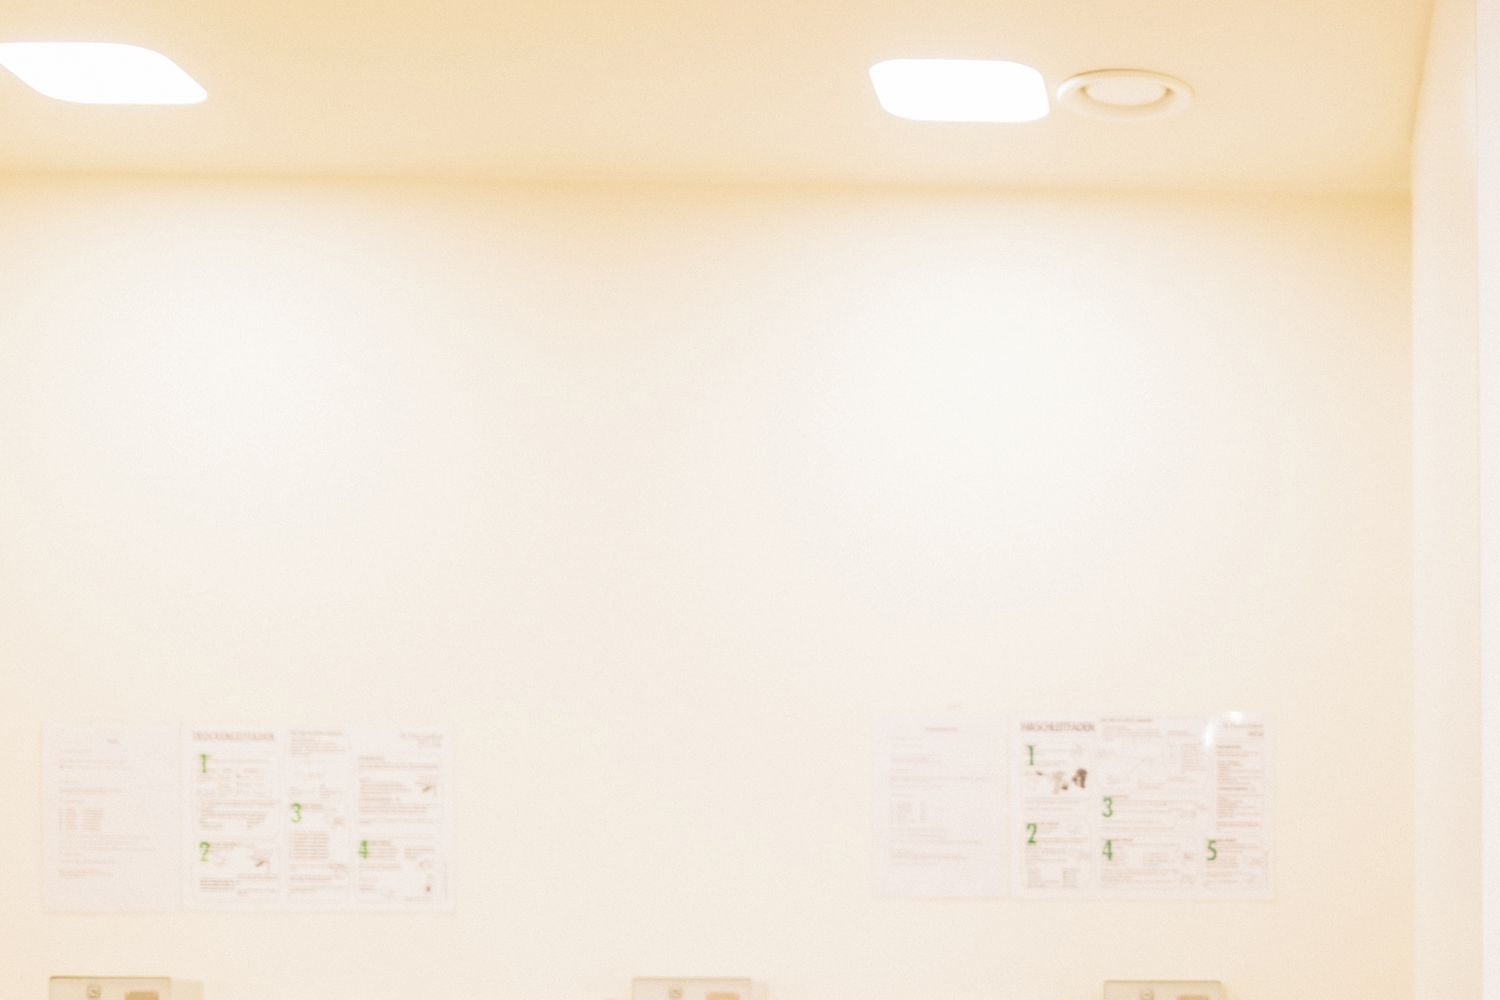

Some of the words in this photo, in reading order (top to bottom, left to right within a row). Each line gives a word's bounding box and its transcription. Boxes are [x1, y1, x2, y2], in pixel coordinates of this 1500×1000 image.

[199, 754, 208, 774] 1
[1026, 745, 1035, 766] 1
[291, 803, 302, 822] 3
[1102, 797, 1113, 818] 3
[1026, 823, 1038, 845] 2
[200, 841, 210, 862] 2
[358, 840, 368, 859] 4
[1102, 840, 1113, 861] 4
[1206, 840, 1218, 861] 5
